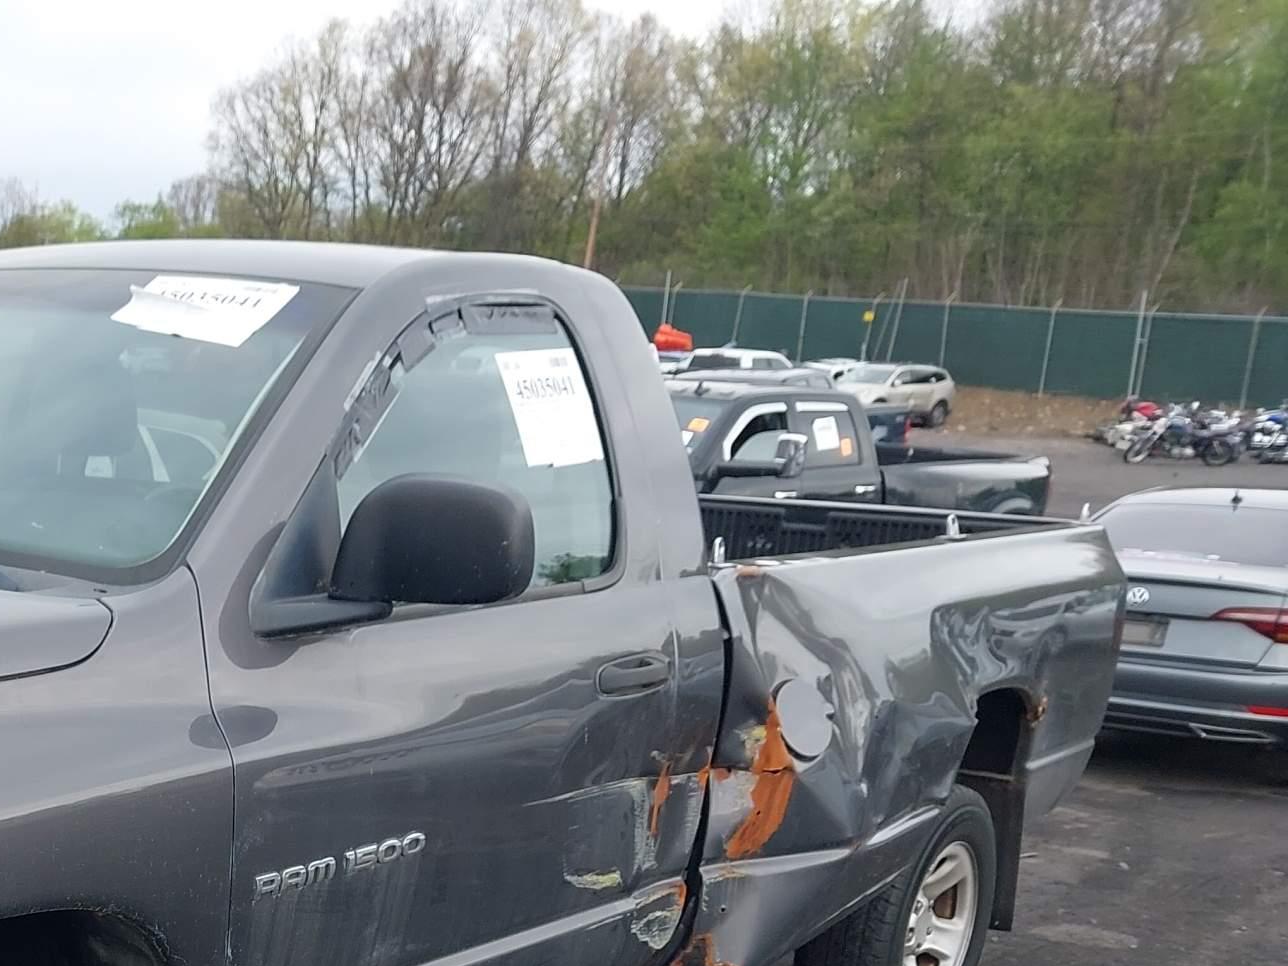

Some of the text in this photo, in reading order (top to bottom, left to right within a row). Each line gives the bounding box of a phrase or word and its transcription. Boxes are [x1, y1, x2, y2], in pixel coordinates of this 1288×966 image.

[515, 375, 577, 400] 45035041
[254, 831, 427, 899] RAM 1500
